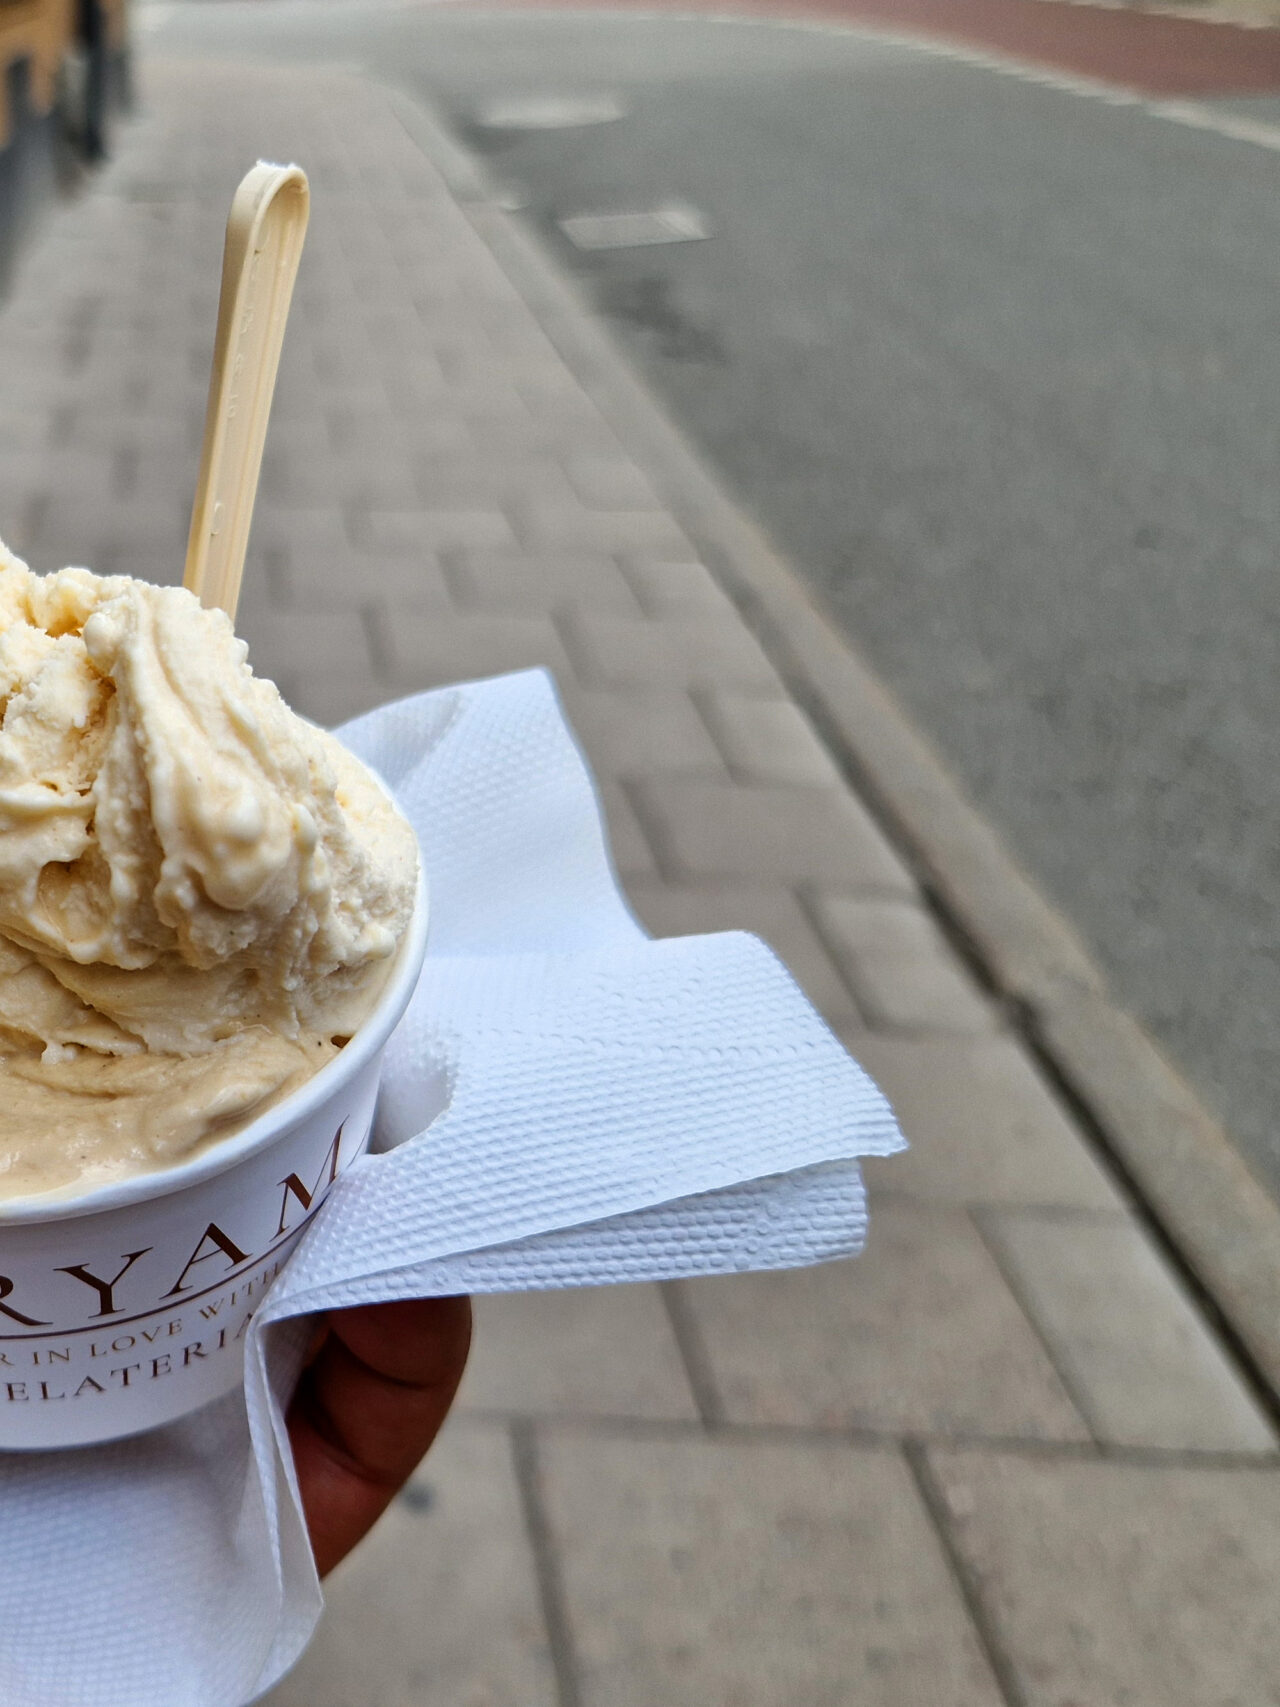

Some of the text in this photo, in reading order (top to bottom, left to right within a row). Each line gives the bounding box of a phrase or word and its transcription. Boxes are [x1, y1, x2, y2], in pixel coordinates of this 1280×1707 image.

[32, 1347, 71, 1365] IN
[90, 1317, 183, 1357] LOVE
[198, 1261, 280, 1321] WITH
